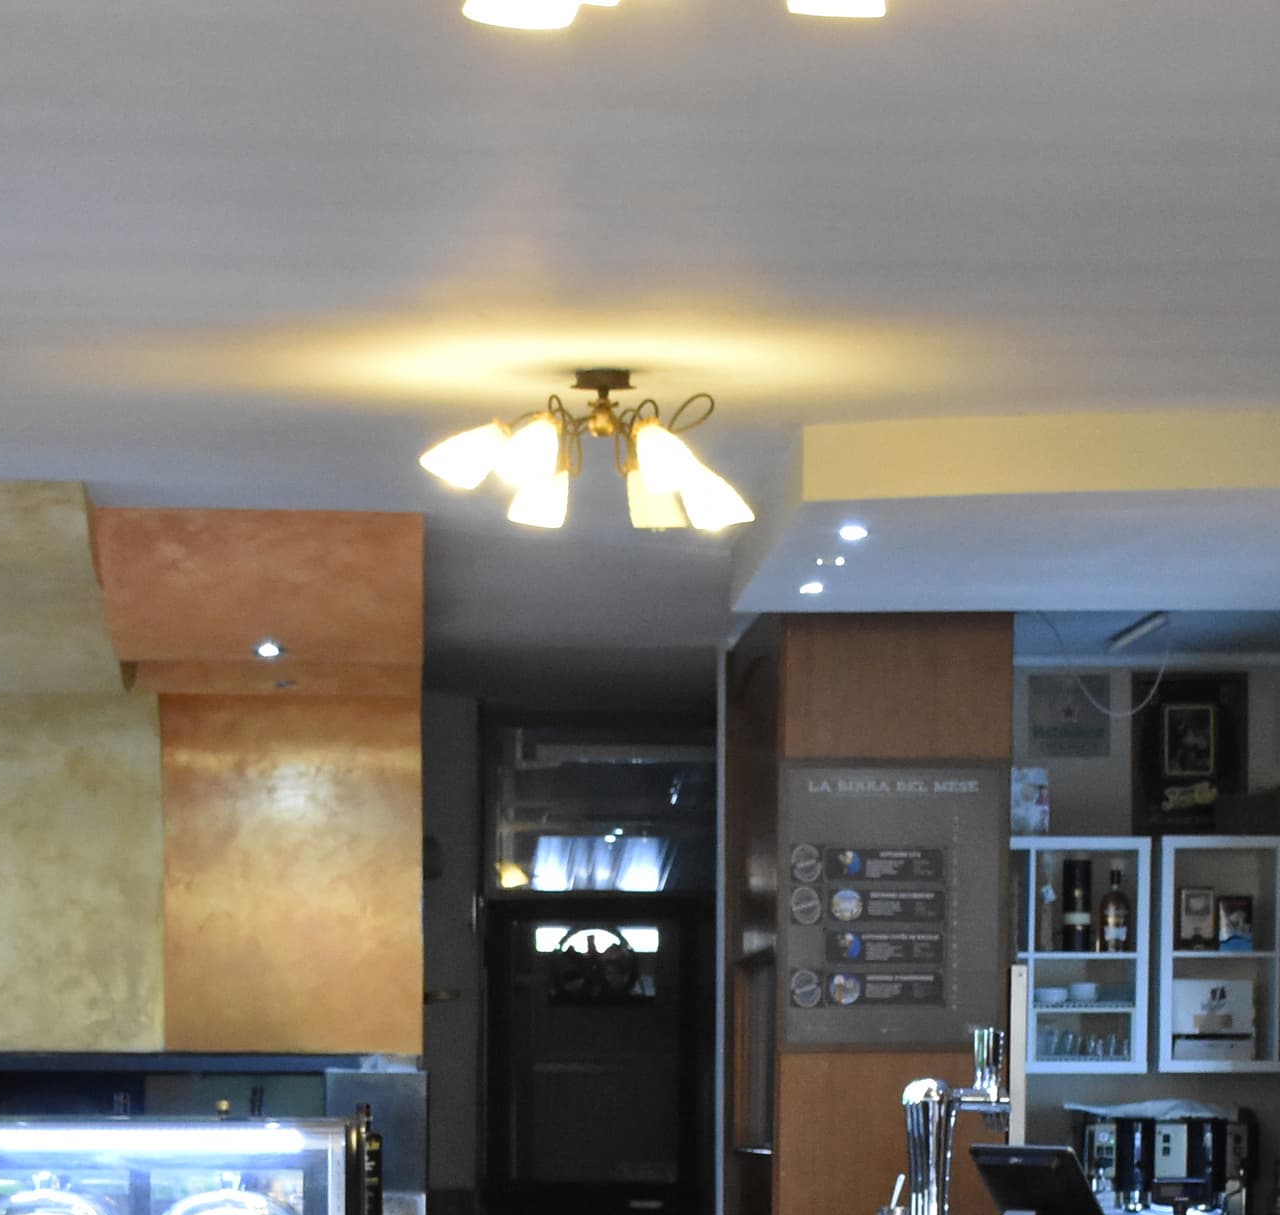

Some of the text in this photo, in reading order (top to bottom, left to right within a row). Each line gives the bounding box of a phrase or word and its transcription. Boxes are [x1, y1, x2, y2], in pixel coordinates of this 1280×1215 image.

[808, 781, 979, 793] LA BIRRA DEL MESE
